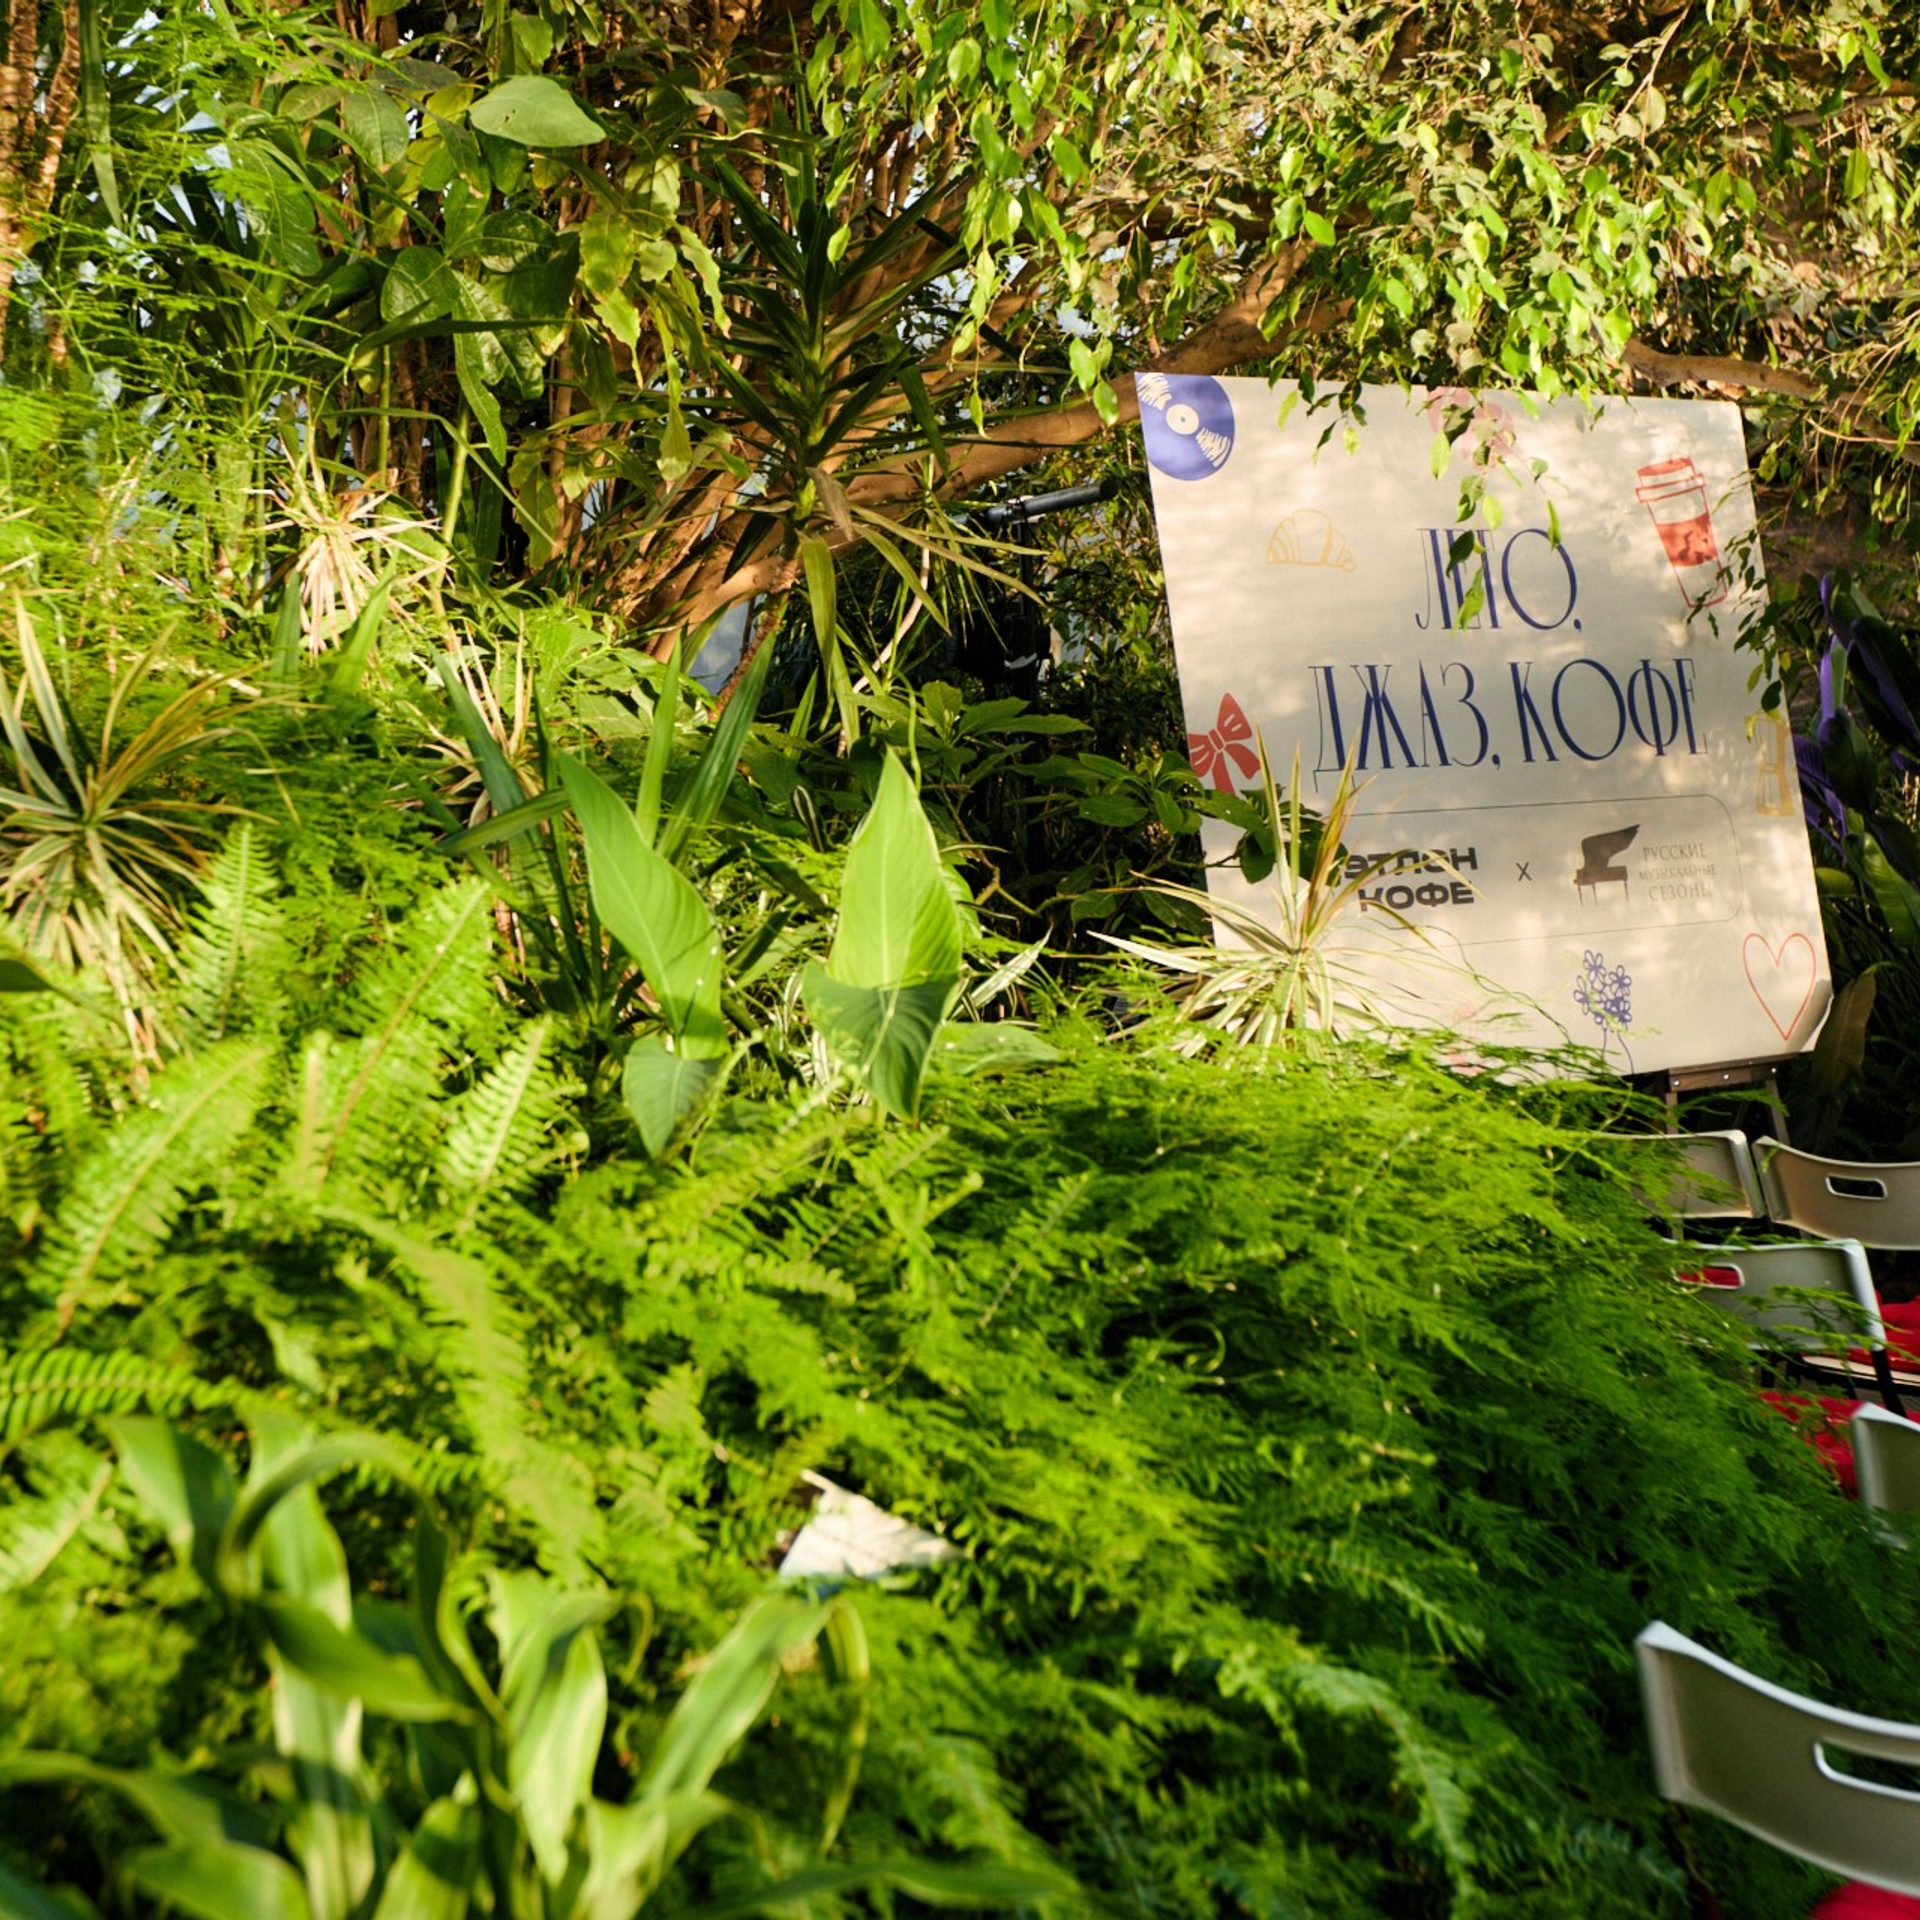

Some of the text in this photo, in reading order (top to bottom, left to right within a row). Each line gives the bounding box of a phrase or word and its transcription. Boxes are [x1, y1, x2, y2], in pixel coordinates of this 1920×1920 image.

[1416, 528, 1582, 632] ЛЕТО,
[1308, 657, 1709, 793] ДЖАЗ, КОФЕ
[1642, 843, 1706, 861] РУССКИЕ
[1358, 881, 1475, 912] КОФЕ
[1648, 882, 1713, 901] СЕЗОНЫ
